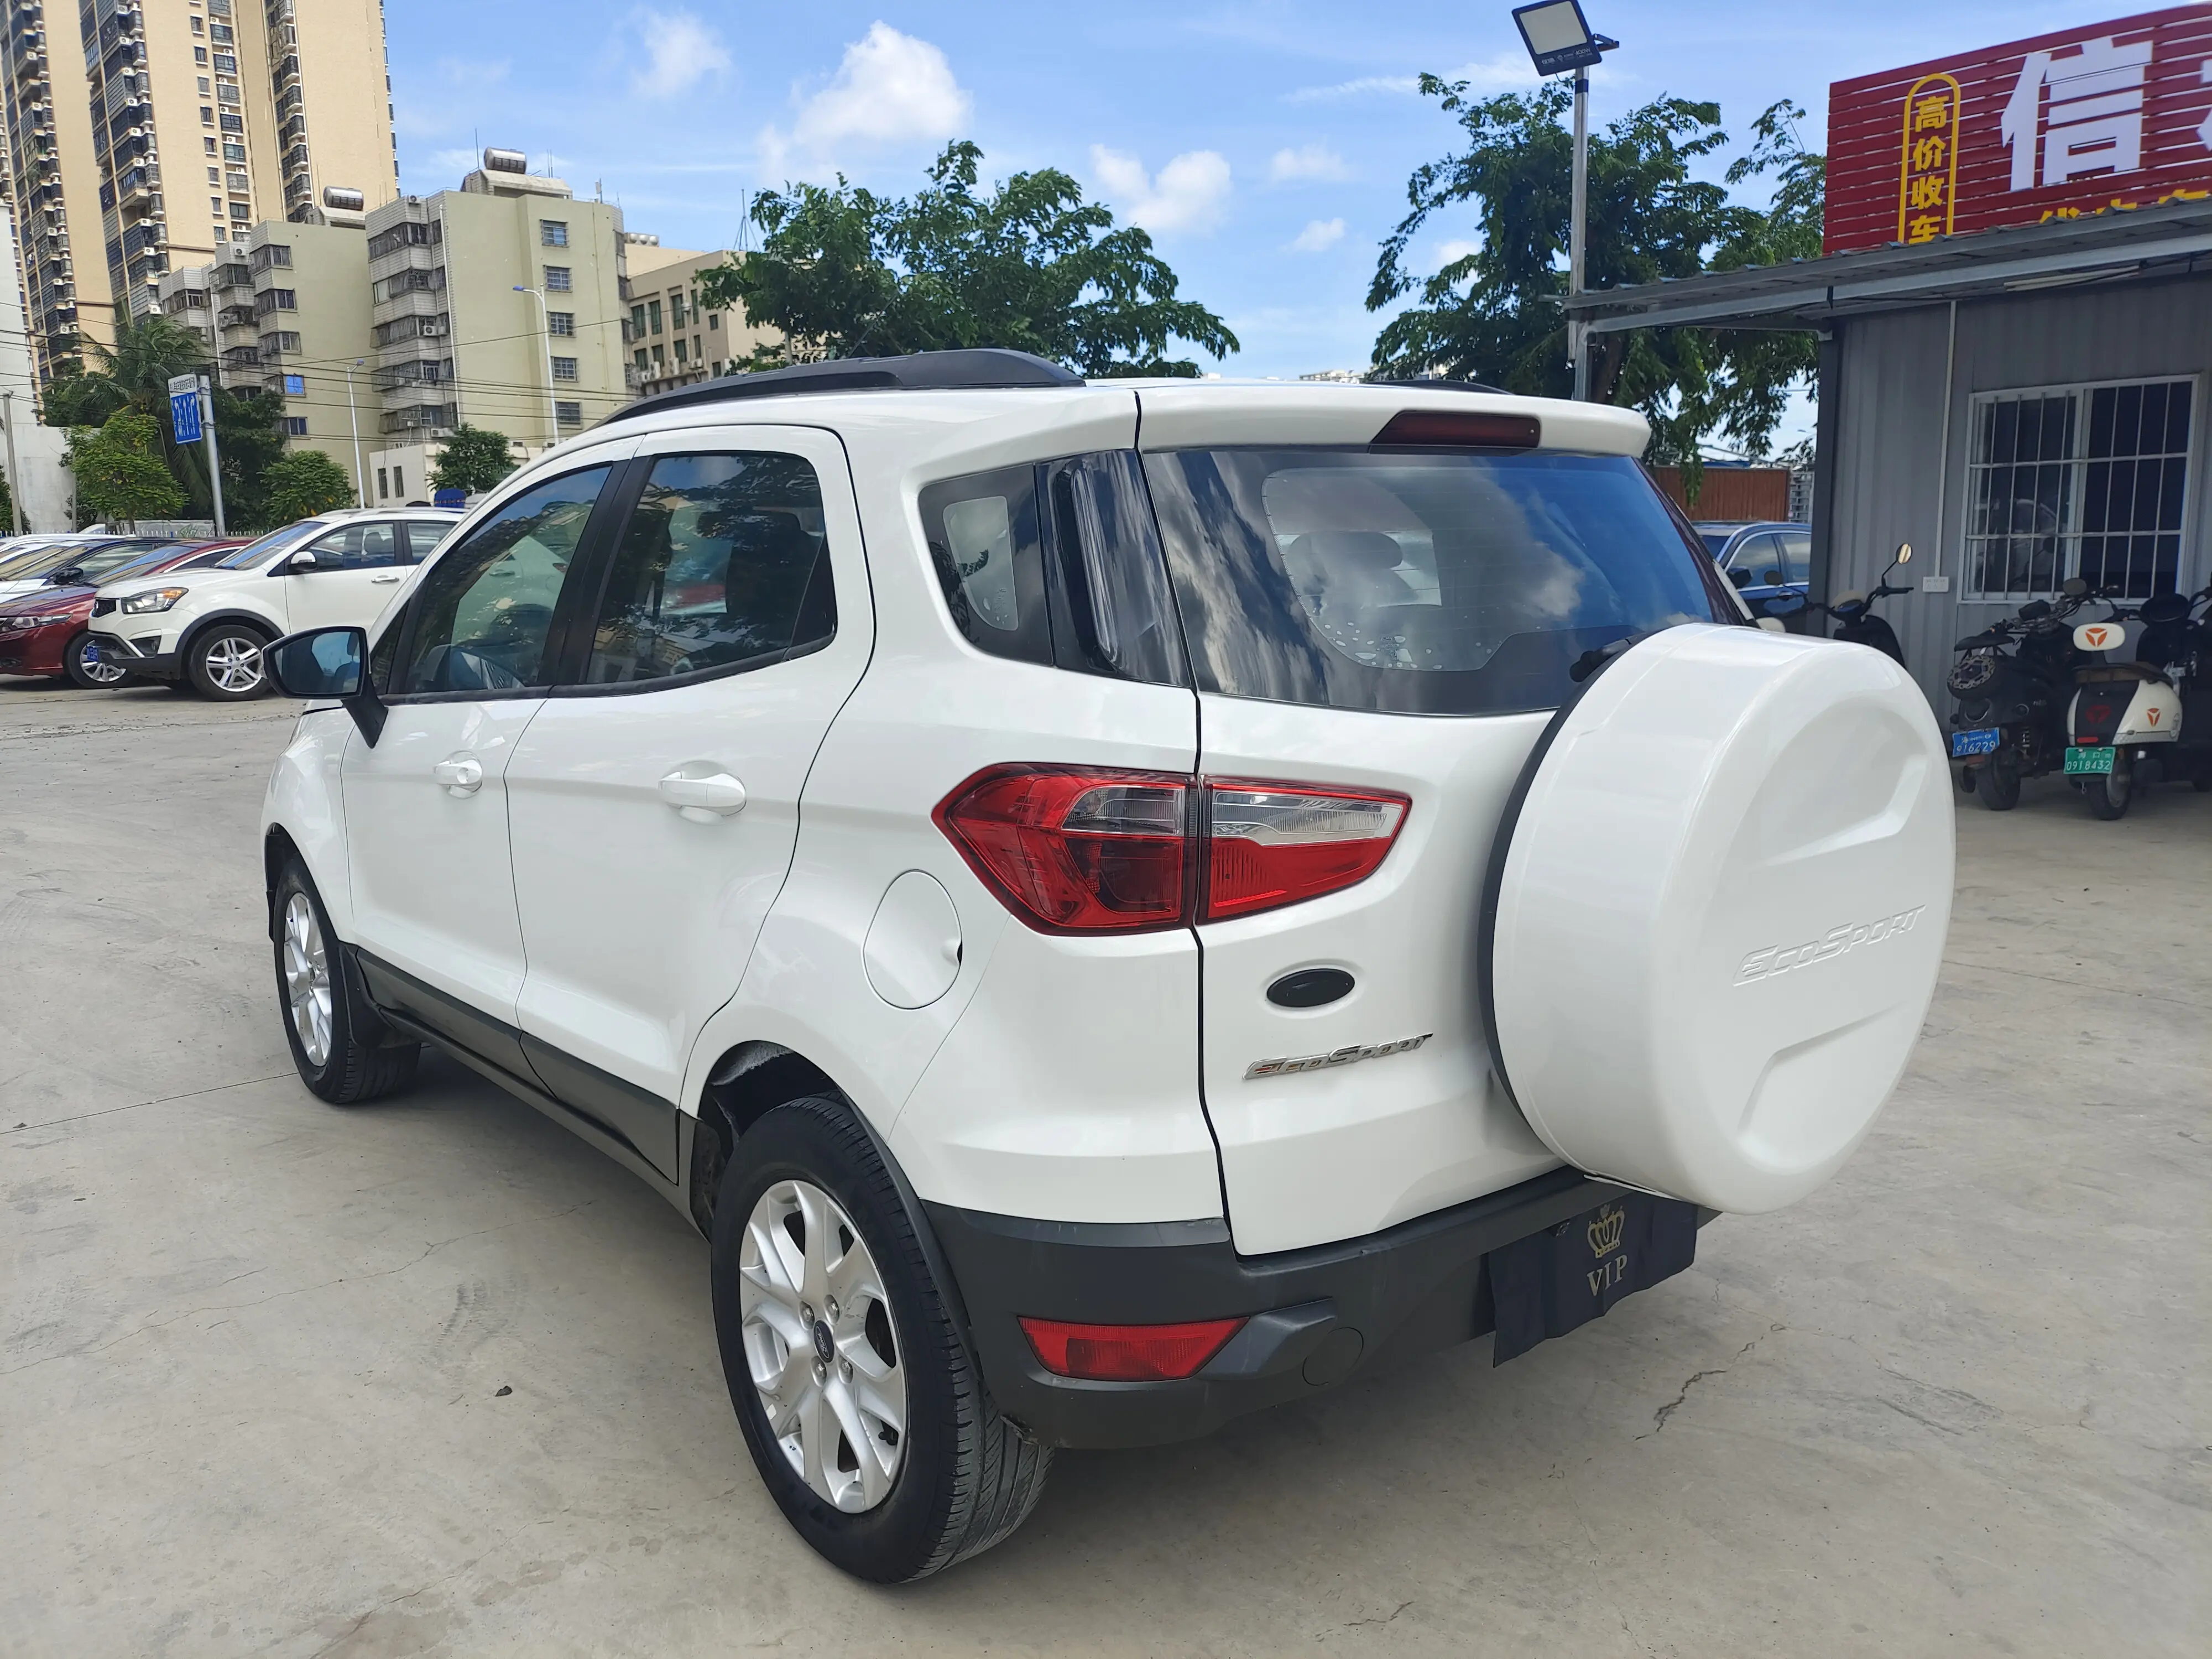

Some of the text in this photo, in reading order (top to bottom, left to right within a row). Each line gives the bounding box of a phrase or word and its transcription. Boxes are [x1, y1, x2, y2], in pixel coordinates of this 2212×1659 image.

[2001, 35, 2212, 191] 信
[1908, 95, 1949, 244] 高价收车
[2067, 760, 2111, 771] 0918432
[1587, 1254, 1627, 1297] VIP
